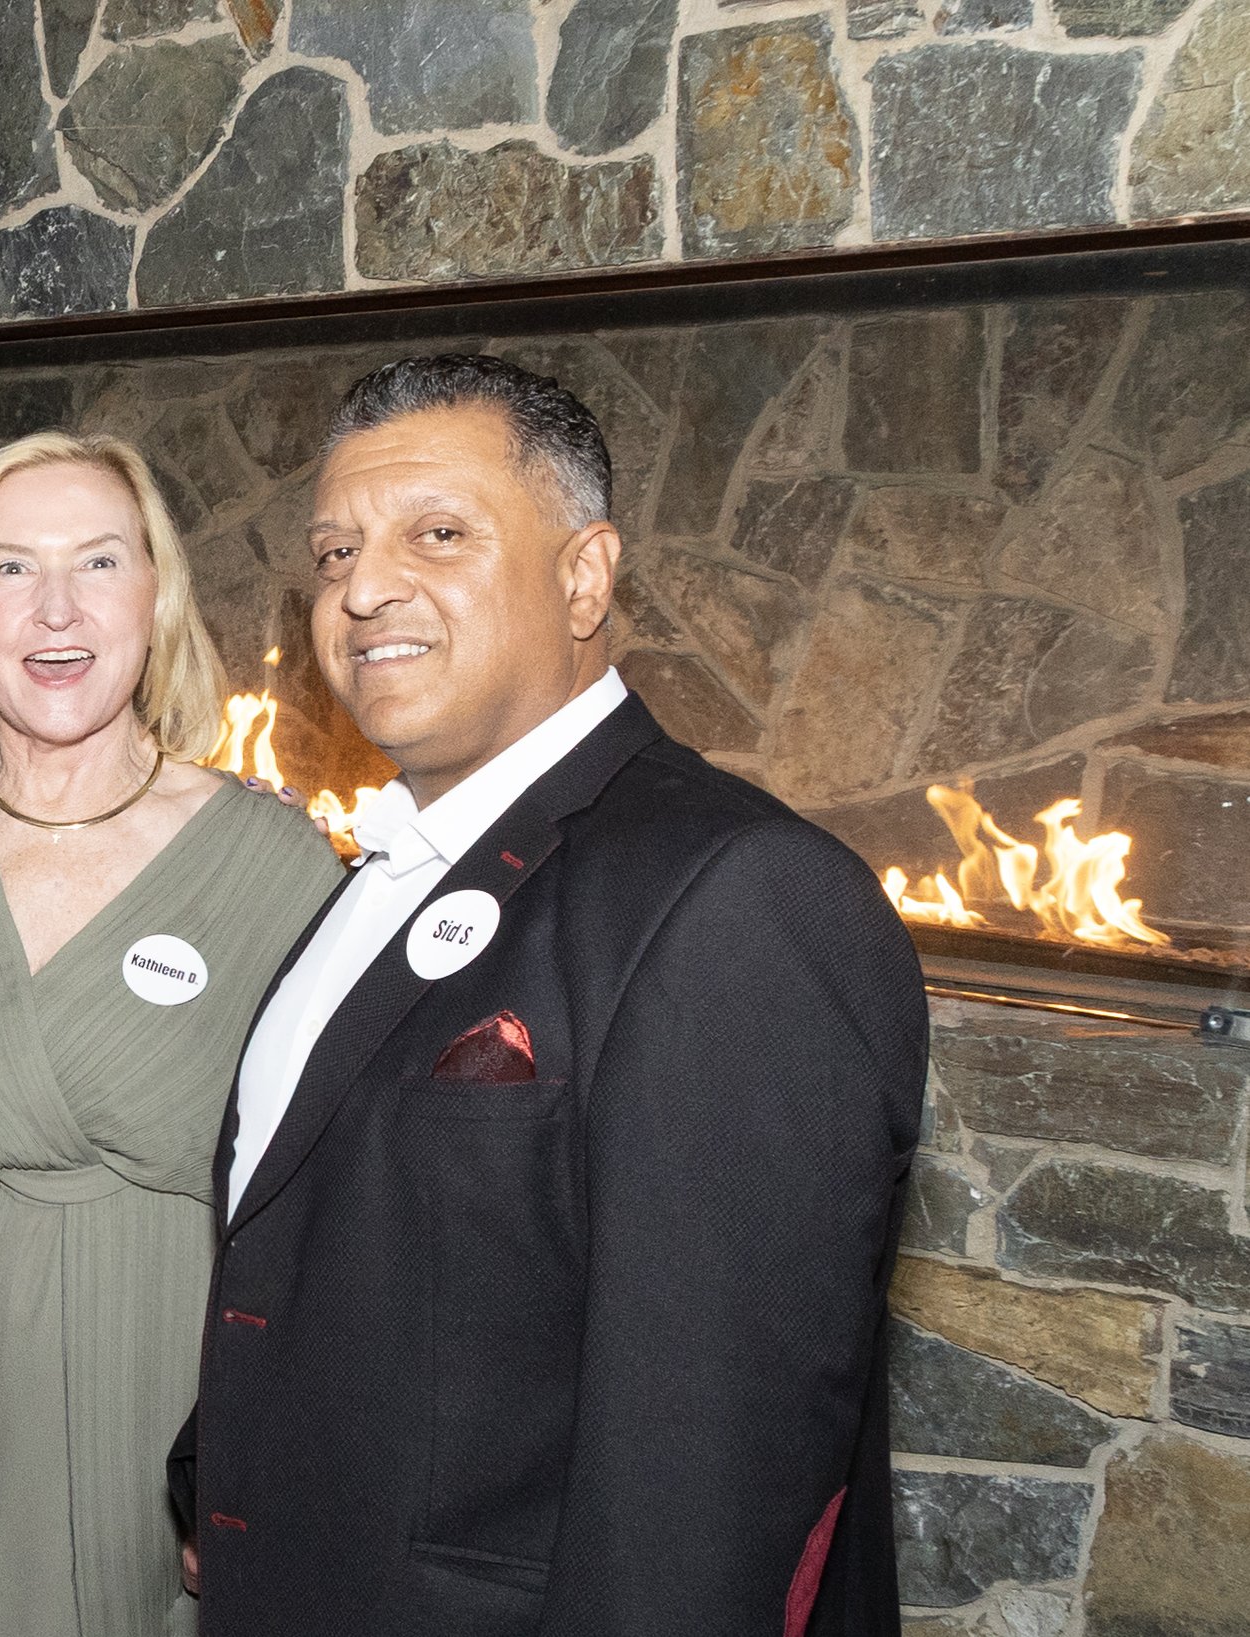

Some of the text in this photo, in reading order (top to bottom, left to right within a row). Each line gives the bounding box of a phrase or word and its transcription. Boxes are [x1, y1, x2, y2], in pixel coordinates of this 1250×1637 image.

[433, 920, 473, 946] Sid S.
[131, 953, 185, 980] Kathleen
